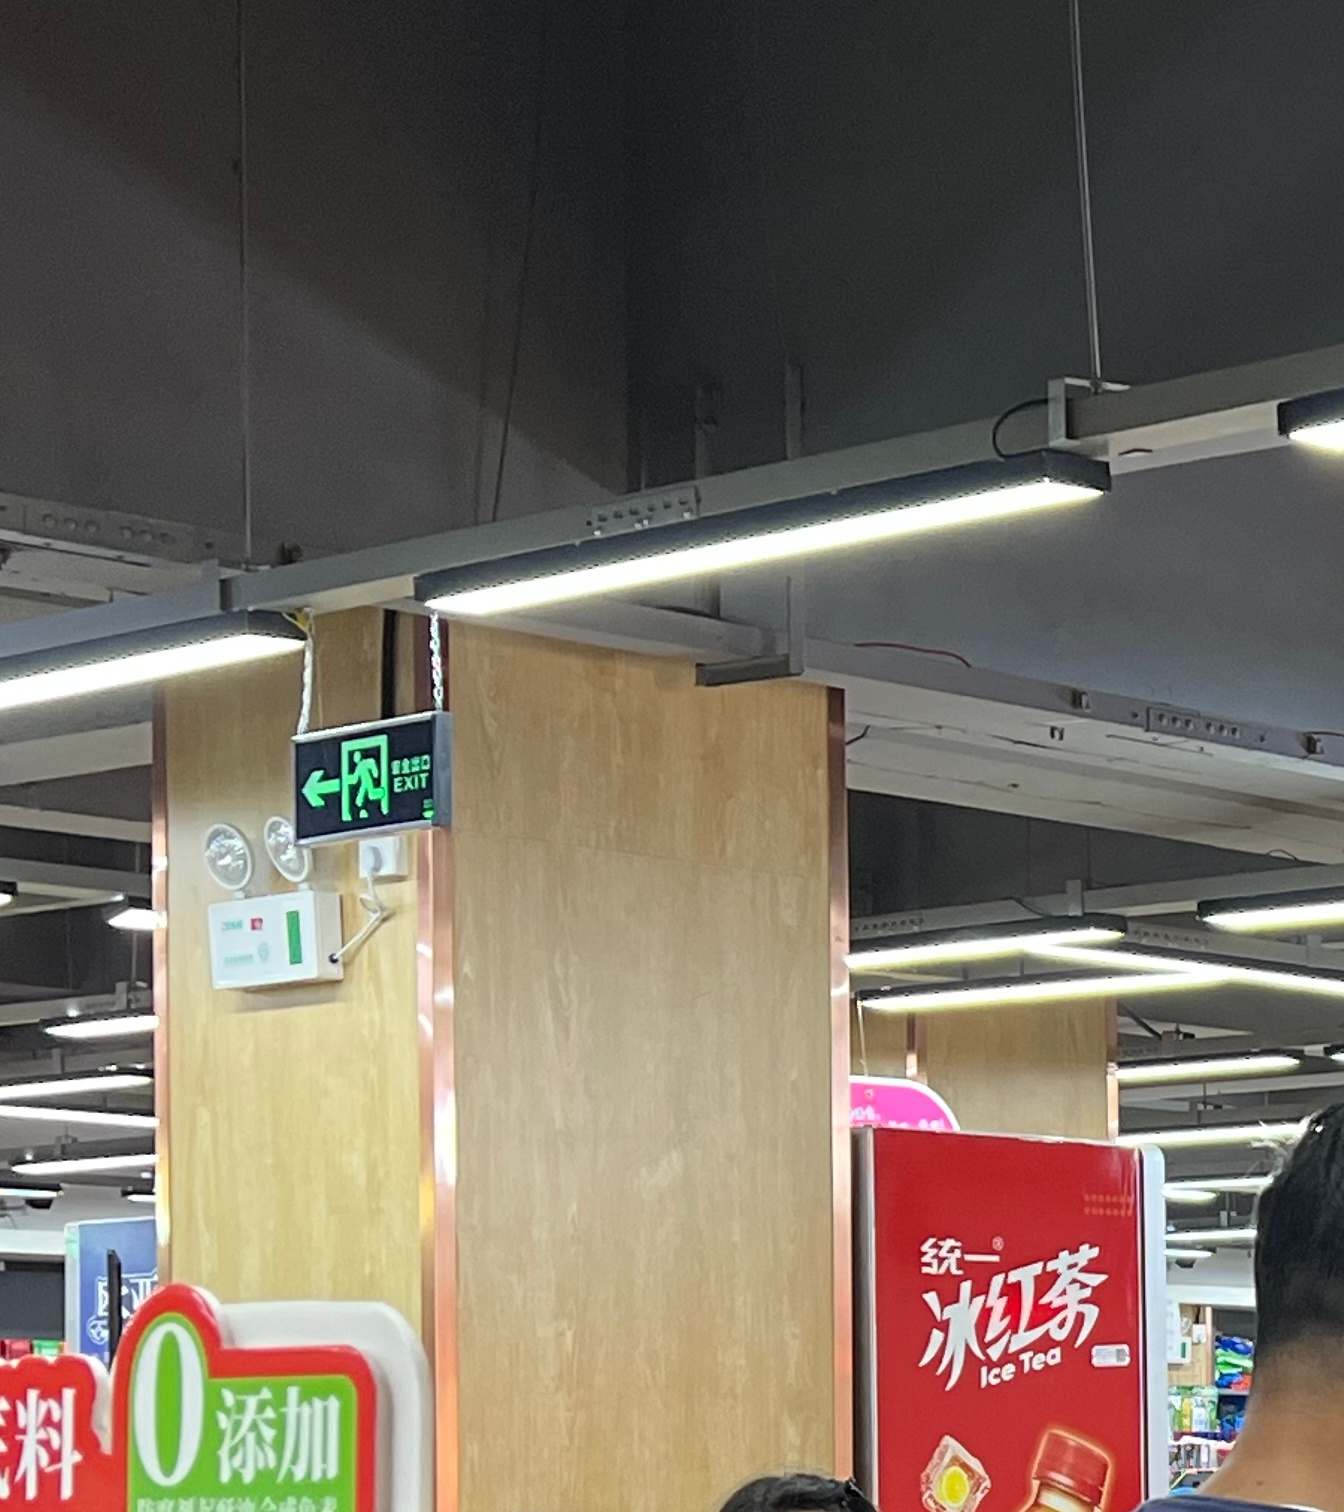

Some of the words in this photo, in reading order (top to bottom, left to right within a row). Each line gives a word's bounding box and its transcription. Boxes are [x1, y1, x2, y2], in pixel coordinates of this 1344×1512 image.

[393, 773, 430, 793] EXIT
[920, 1237, 1001, 1276] 统一
[917, 1243, 1110, 1393] 冰红茶
[133, 1321, 205, 1487] 0
[216, 1385, 341, 1485] 添加
[980, 1363, 1017, 1389] Ice
[1018, 1346, 1062, 1375] Tea
[0, 1387, 84, 1501] 料
